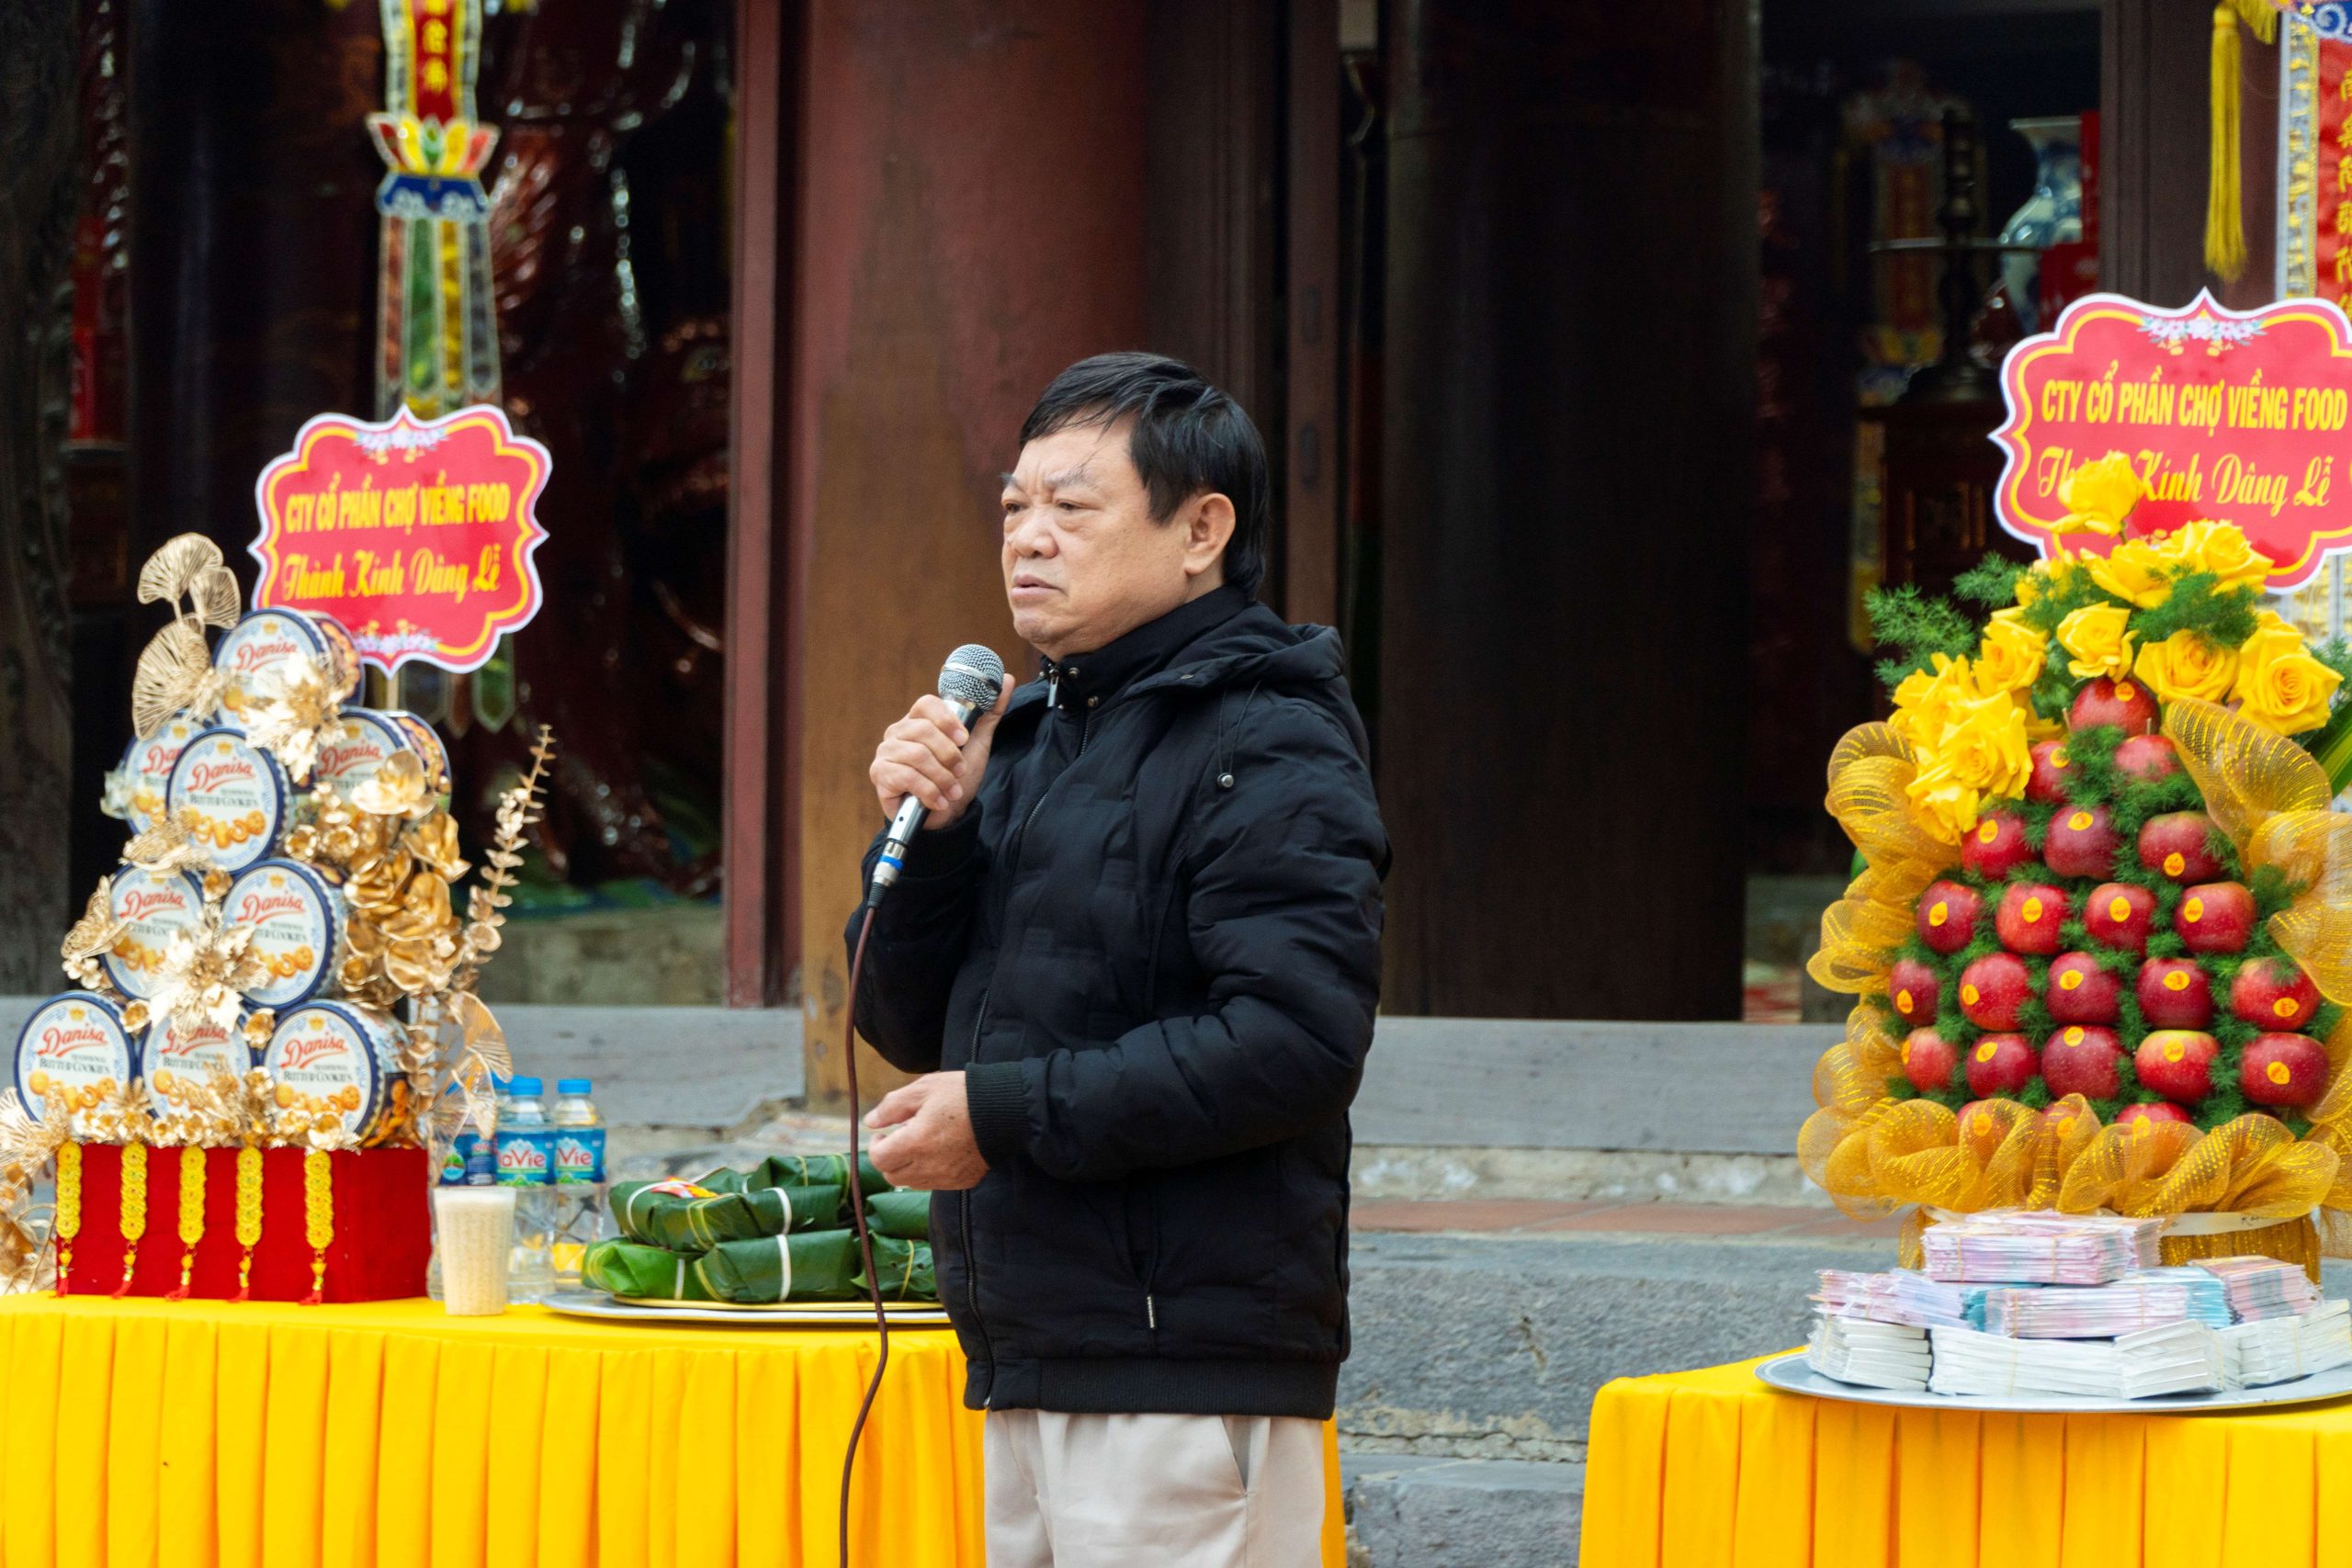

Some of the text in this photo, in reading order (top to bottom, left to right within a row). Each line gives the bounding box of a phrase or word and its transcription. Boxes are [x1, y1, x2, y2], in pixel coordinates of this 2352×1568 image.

[2041, 359, 2348, 437] CTY CỔ PHẦN CHỢ VIỀNG FOOD
[2133, 448, 2203, 503] Kính
[2211, 453, 2289, 517] Dâng
[2293, 456, 2335, 507] Lễ
[285, 491, 318, 534] CTY
[315, 470, 341, 532] CỔ
[383, 480, 419, 536] CHỢ
[466, 482, 512, 524] FOOD
[281, 543, 502, 604] Thành Kính Dâng Lễ
[235, 636, 298, 672] Danisa
[187, 756, 256, 793] Danisa
[317, 739, 383, 777] Danisa
[119, 886, 187, 921] Danisa
[236, 889, 306, 925] Danisa
[37, 1022, 108, 1057] Danisa
[279, 1031, 349, 1069] Danisa
